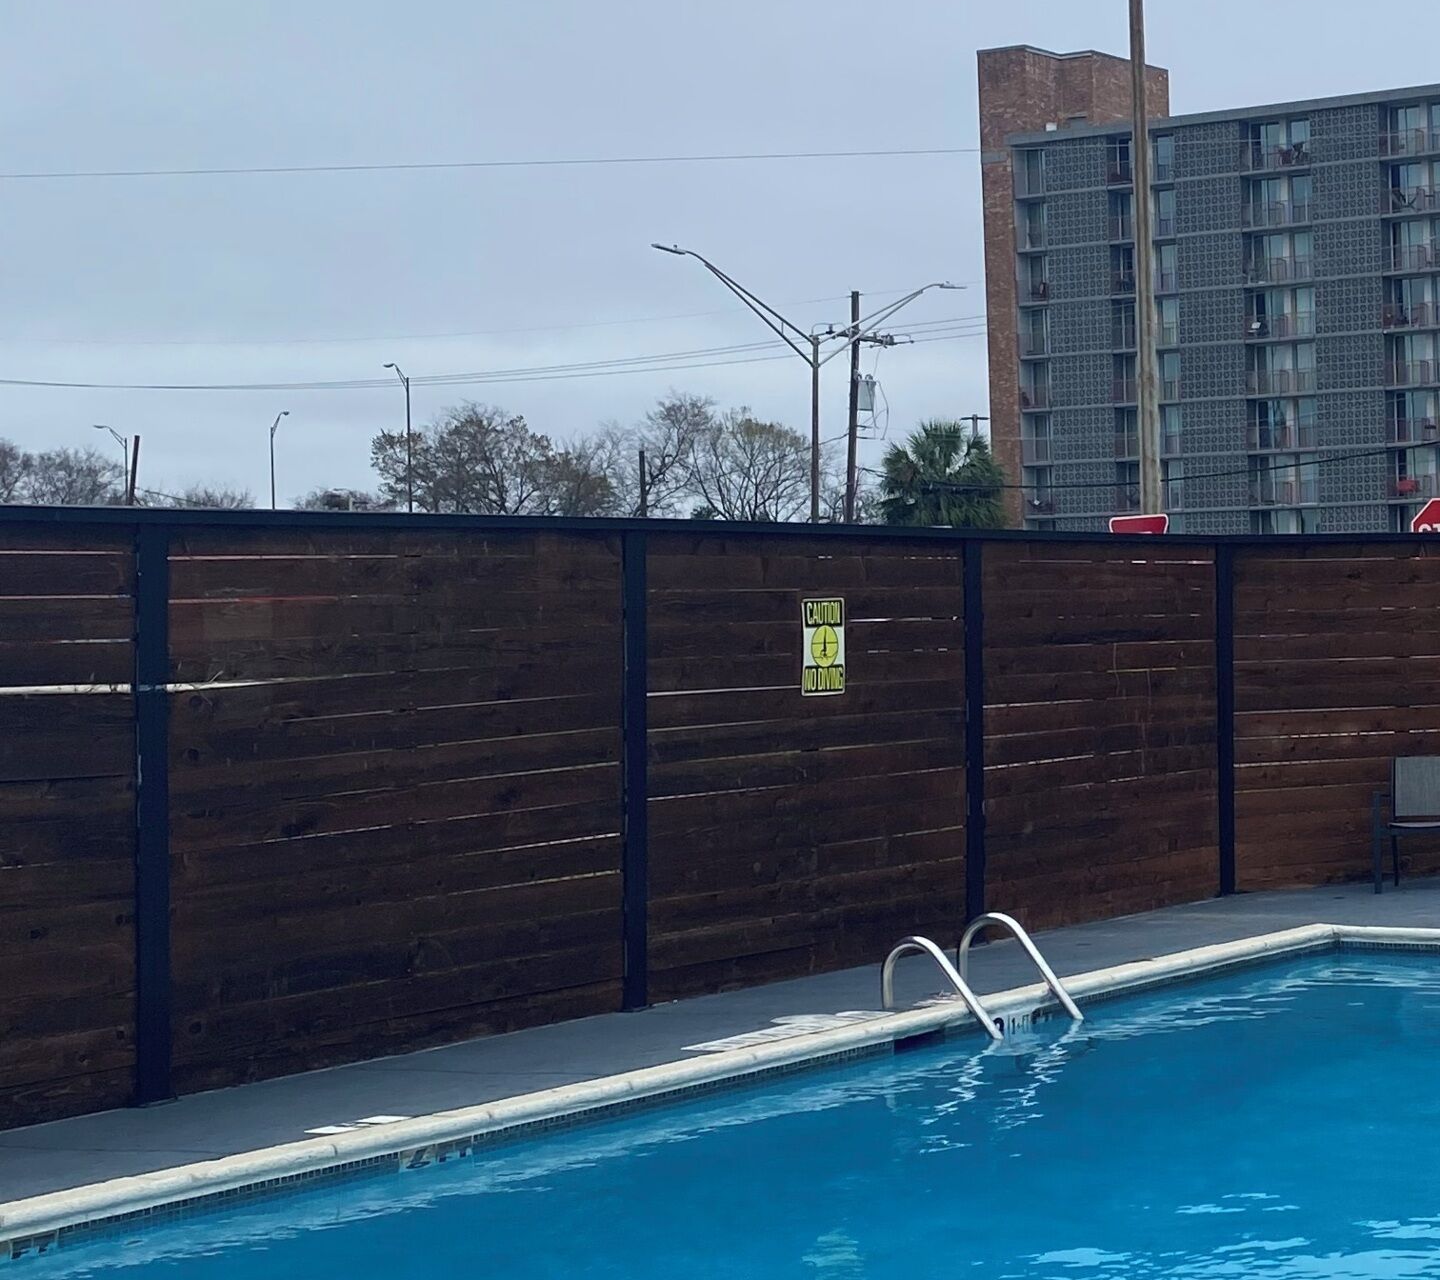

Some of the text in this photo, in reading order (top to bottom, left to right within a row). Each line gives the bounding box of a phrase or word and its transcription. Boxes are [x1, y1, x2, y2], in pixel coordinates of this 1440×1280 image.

[806, 601, 841, 625] CAUTION
[804, 666, 844, 691] NO DIVING
